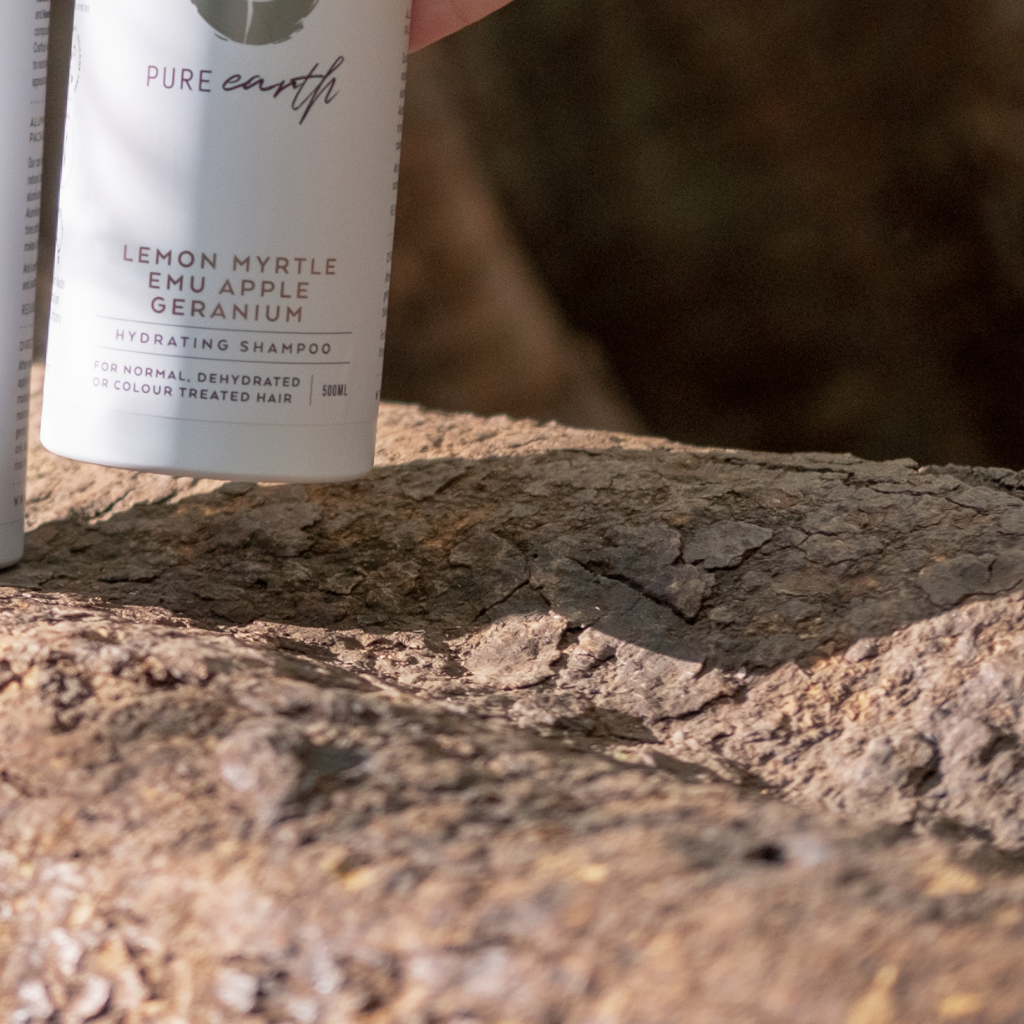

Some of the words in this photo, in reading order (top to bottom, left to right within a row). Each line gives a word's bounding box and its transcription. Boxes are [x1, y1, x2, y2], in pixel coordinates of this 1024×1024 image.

[146, 65, 212, 92] PURE
[222, 55, 345, 125] earth
[122, 244, 217, 270] LEMON
[232, 255, 337, 275] MYRTLE
[148, 271, 206, 294] EMU
[218, 279, 310, 299] APPLE
[150, 296, 303, 323] GERANIUM
[115, 329, 229, 352] HYDRATING
[240, 340, 332, 355] SHAMPOO
[93, 360, 118, 374] FOR
[123, 365, 191, 383] NORMAL,
[197, 372, 301, 388] DEHYDRATED
[92, 377, 109, 389] OR
[113, 380, 173, 397] COLOUR
[179, 386, 250, 402] TREATED
[256, 392, 293, 404] HAIR
[321, 383, 348, 397] 500ML
